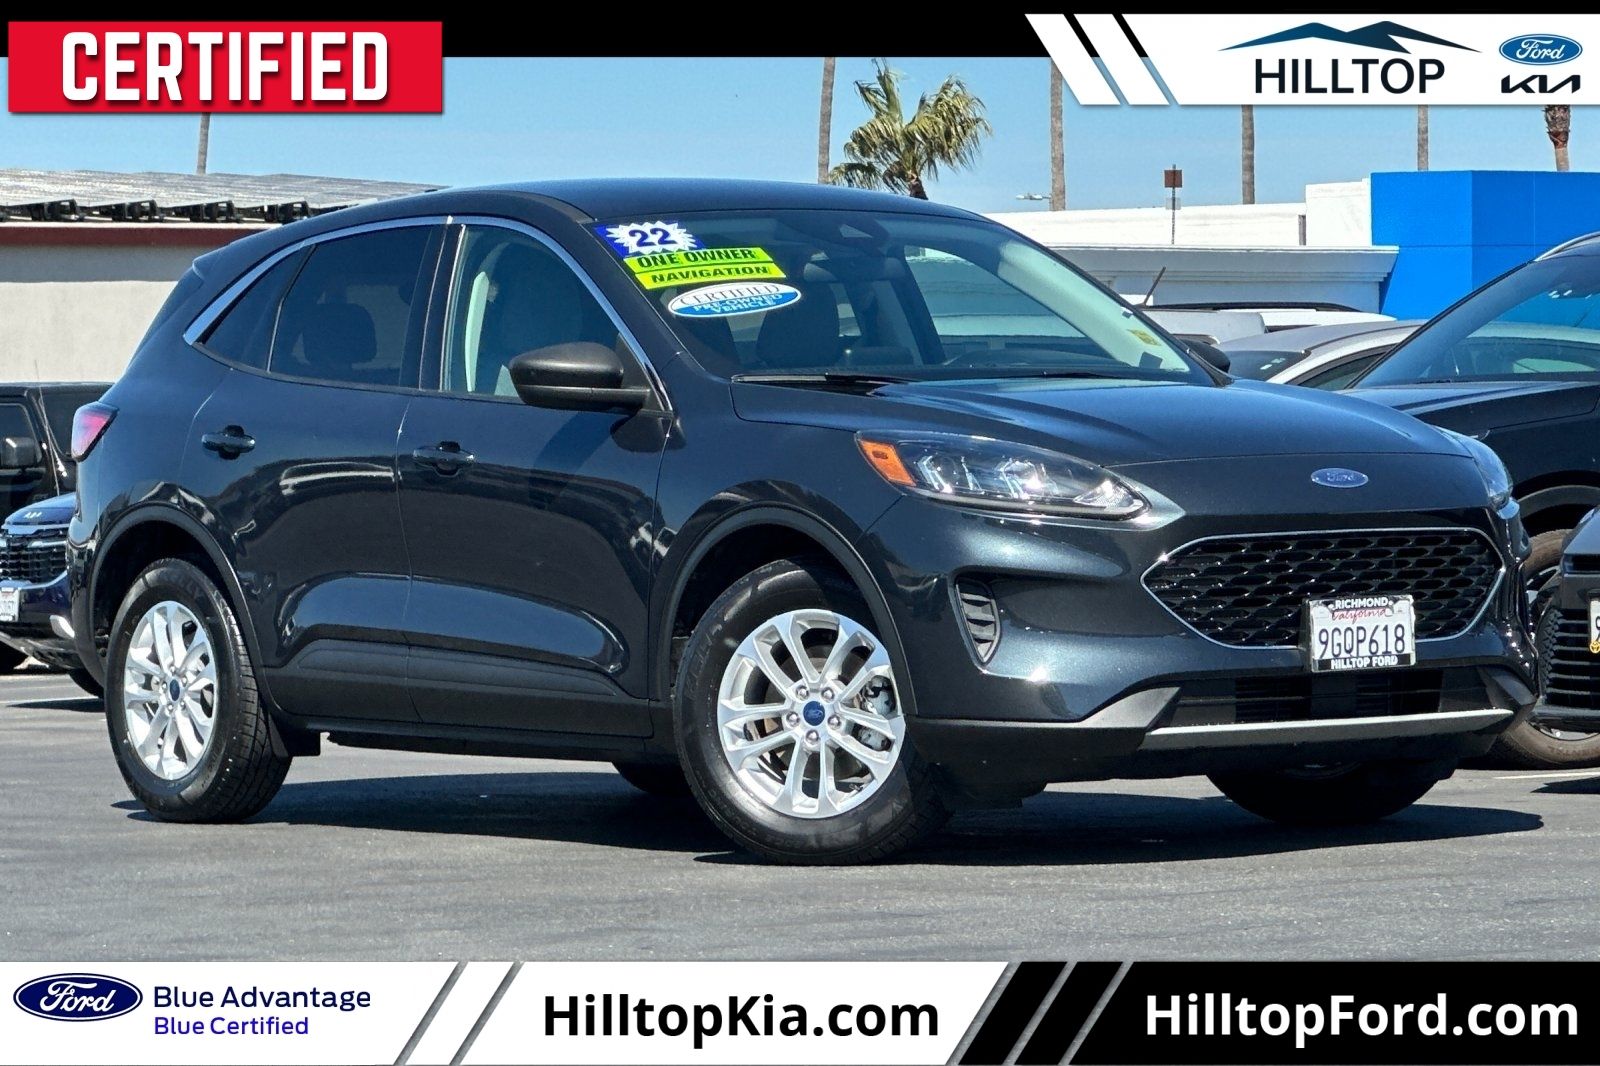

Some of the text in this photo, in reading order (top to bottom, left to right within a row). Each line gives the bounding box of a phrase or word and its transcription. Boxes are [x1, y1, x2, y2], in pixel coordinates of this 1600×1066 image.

[628, 227, 678, 247] 22
[637, 249, 756, 268] ONE OWNER
[651, 266, 768, 282] NAVIGATION
[680, 284, 779, 306] CERTIFIED
[692, 294, 783, 312] PRE-OWNED
[711, 301, 777, 314] VEHICLE
[1334, 596, 1389, 609] RICHMOND
[1318, 623, 1405, 660] 9GQP618
[1330, 655, 1399, 670] HILLTOP FORD
